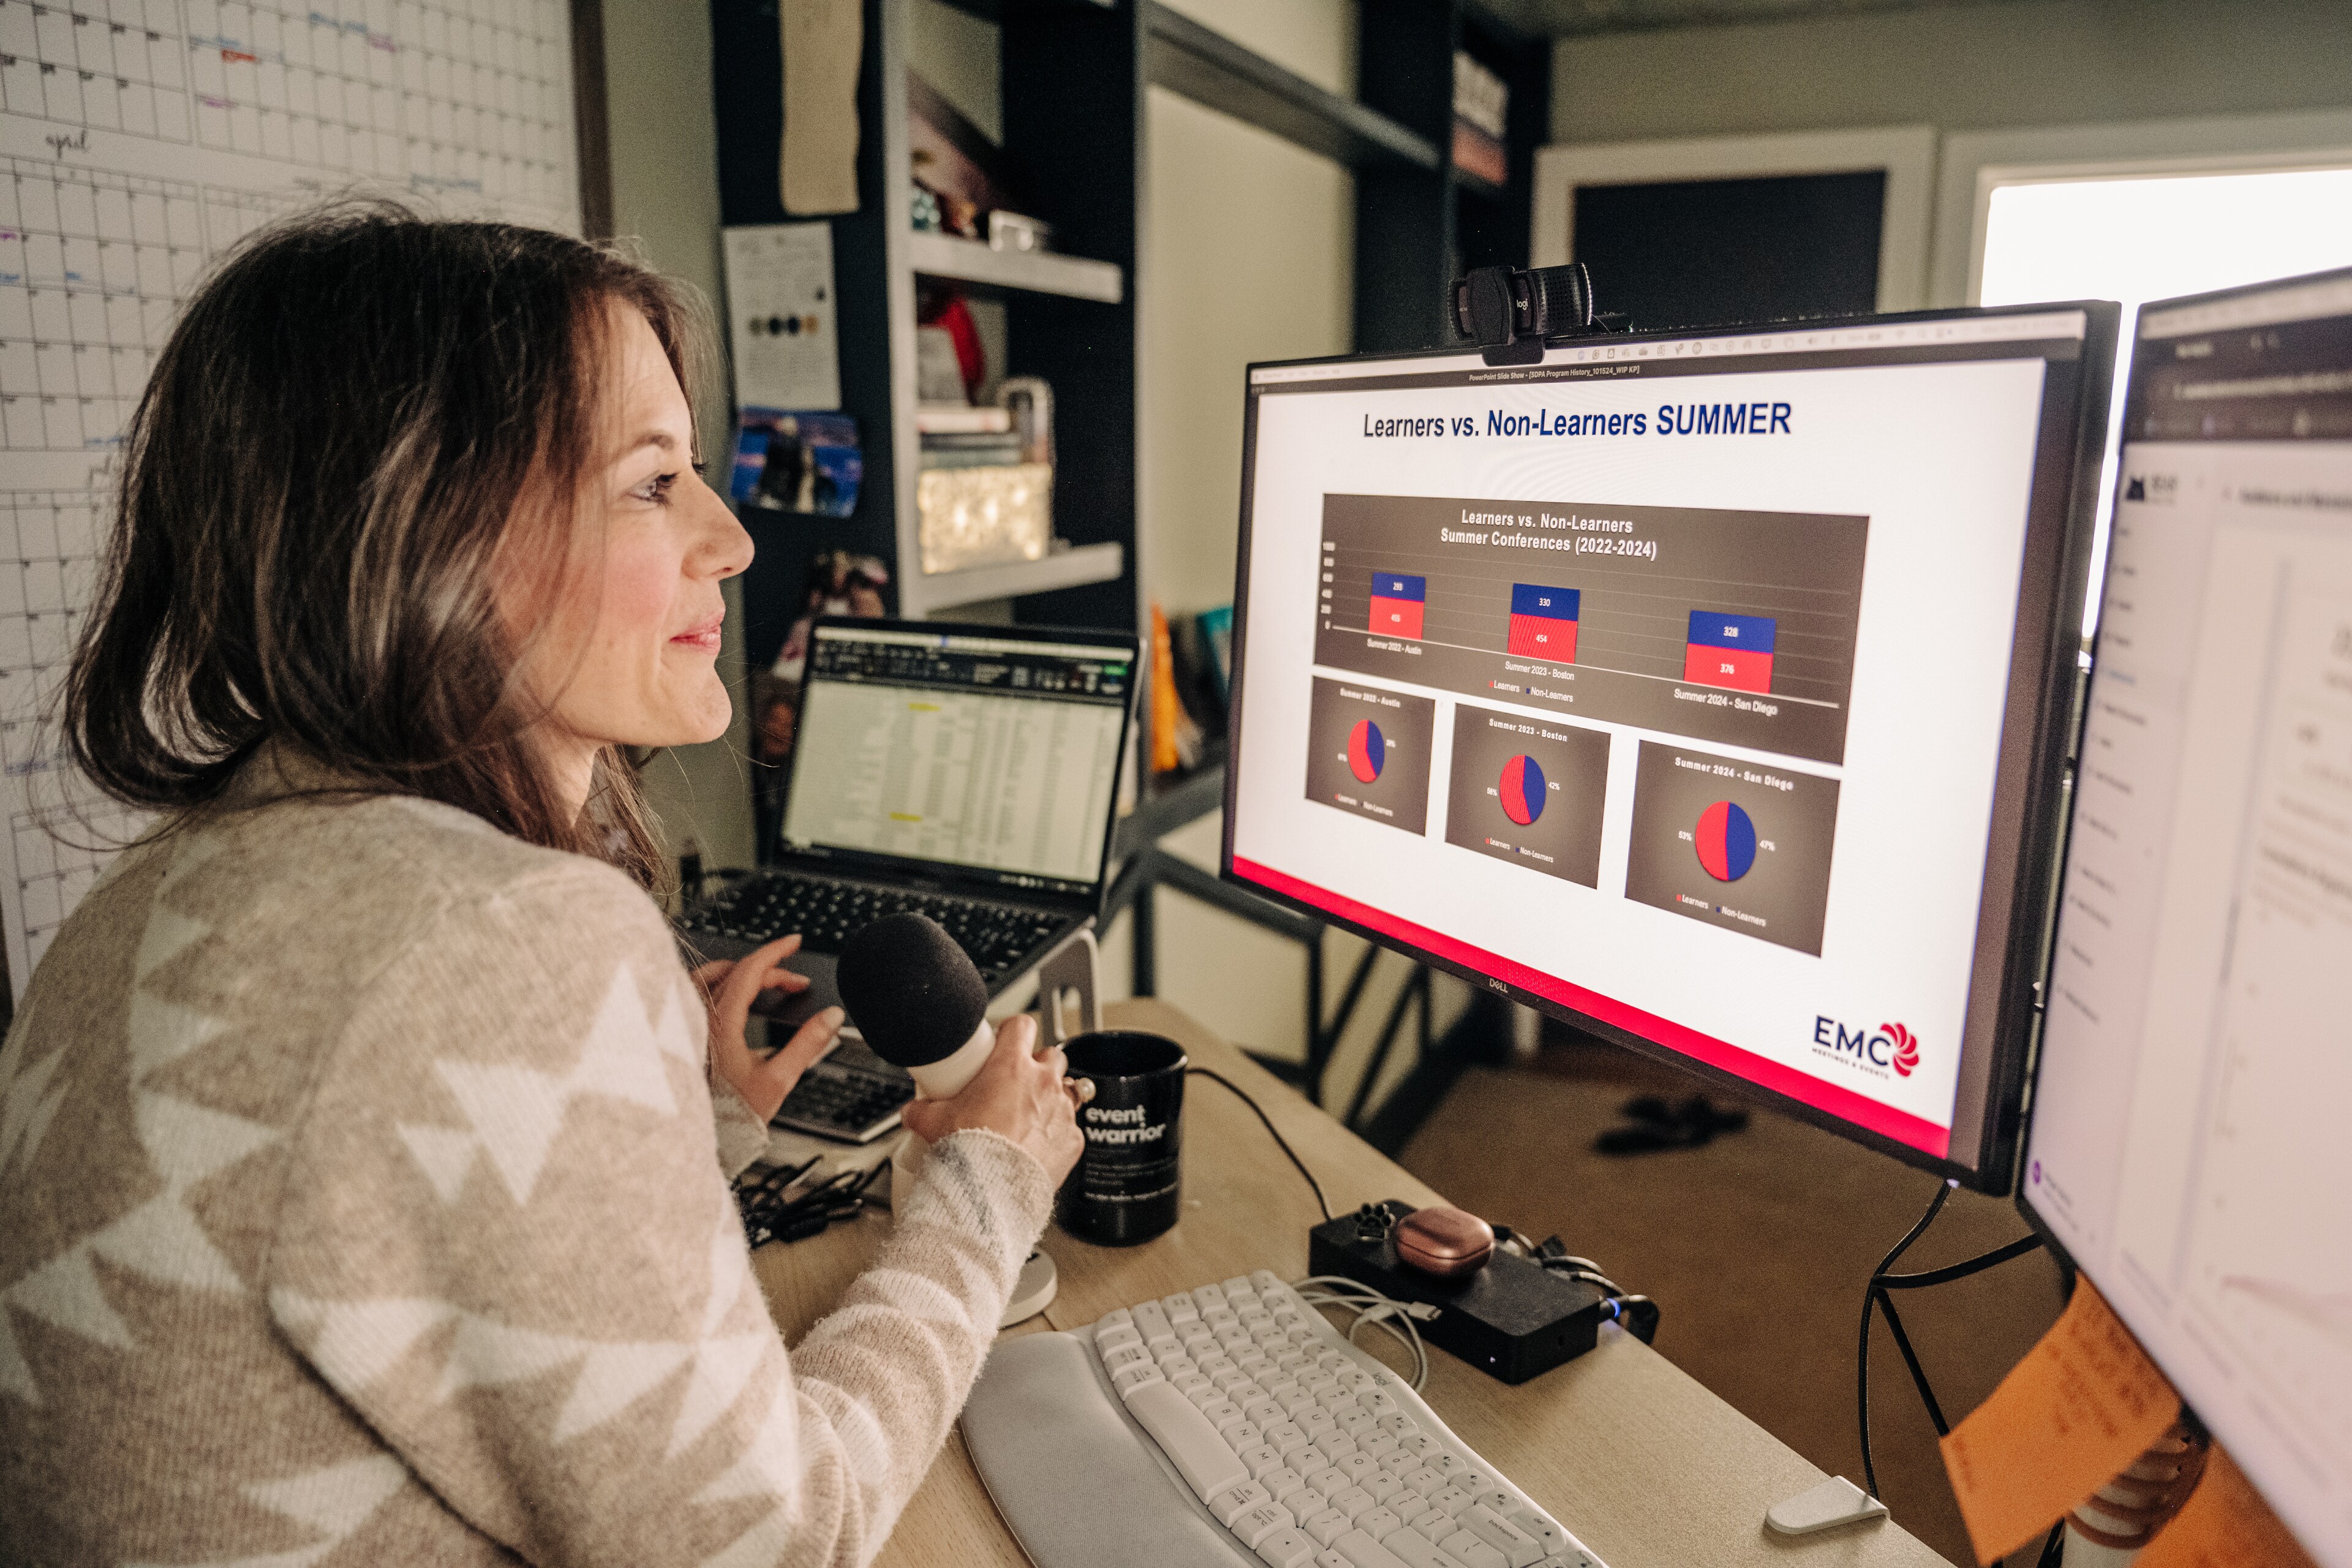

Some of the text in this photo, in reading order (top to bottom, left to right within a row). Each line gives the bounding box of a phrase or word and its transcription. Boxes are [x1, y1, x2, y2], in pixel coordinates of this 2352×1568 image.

[1517, 298, 1528, 311] logi
[1529, 371, 1545, 379] [SDPA
[1570, 366, 1627, 377] History_101524_WIP
[1629, 365, 1640, 374] KP]
[1364, 402, 1792, 437] Learners vs. Non-Learners SUMMER
[1461, 509, 1633, 533] Learners vs. Non-Learners
[1441, 527, 1657, 561] Summer Conferences (2022-2024)
[1393, 582, 1403, 591] 293
[1539, 598, 1550, 606] 330
[1536, 635, 1547, 643] 454
[1723, 626, 1738, 638] 328
[1367, 638, 1387, 649] Summer
[1389, 643, 1401, 652] 2022
[1404, 644, 1422, 655] Austin
[1505, 661, 1531, 673] Summer
[1531, 666, 1547, 676] 2023
[1553, 669, 1574, 680] Boston
[1720, 663, 1735, 674] 376
[1494, 680, 1520, 692] Learners
[1531, 687, 1573, 702] Non-Learners
[1674, 688, 1707, 703] Summer
[1708, 693, 1727, 706] 2024
[1735, 698, 1751, 710] San
[1752, 701, 1778, 717] Diego
[1489, 718, 1516, 731] Summer
[1518, 725, 1534, 735] 2023
[1542, 729, 1567, 742] Boston
[1675, 756, 1711, 772] Summer
[1713, 764, 1735, 778] 2024
[1744, 771, 1762, 783] San
[1764, 776, 1794, 791] Diego
[1487, 787, 1497, 796] 58%
[1548, 782, 1560, 791] 42%
[1678, 831, 1692, 841] 53%
[1490, 838, 1510, 850] Learners
[1759, 840, 1775, 851] 47%
[1520, 847, 1553, 863] Non-Learners
[1682, 894, 1708, 909] Learners
[1722, 906, 1766, 927] Non-Learners
[1490, 978, 1508, 993] DELL
[1814, 1015, 1890, 1066] EMC
[1085, 1104, 1145, 1124] event
[1085, 1122, 1167, 1144] warrior
[1373, 1372, 1392, 1385] logi
[1229, 1490, 1240, 1501] cmd
[1488, 1519, 1518, 1541] backspace
[1433, 1557, 1449, 1567] enter
